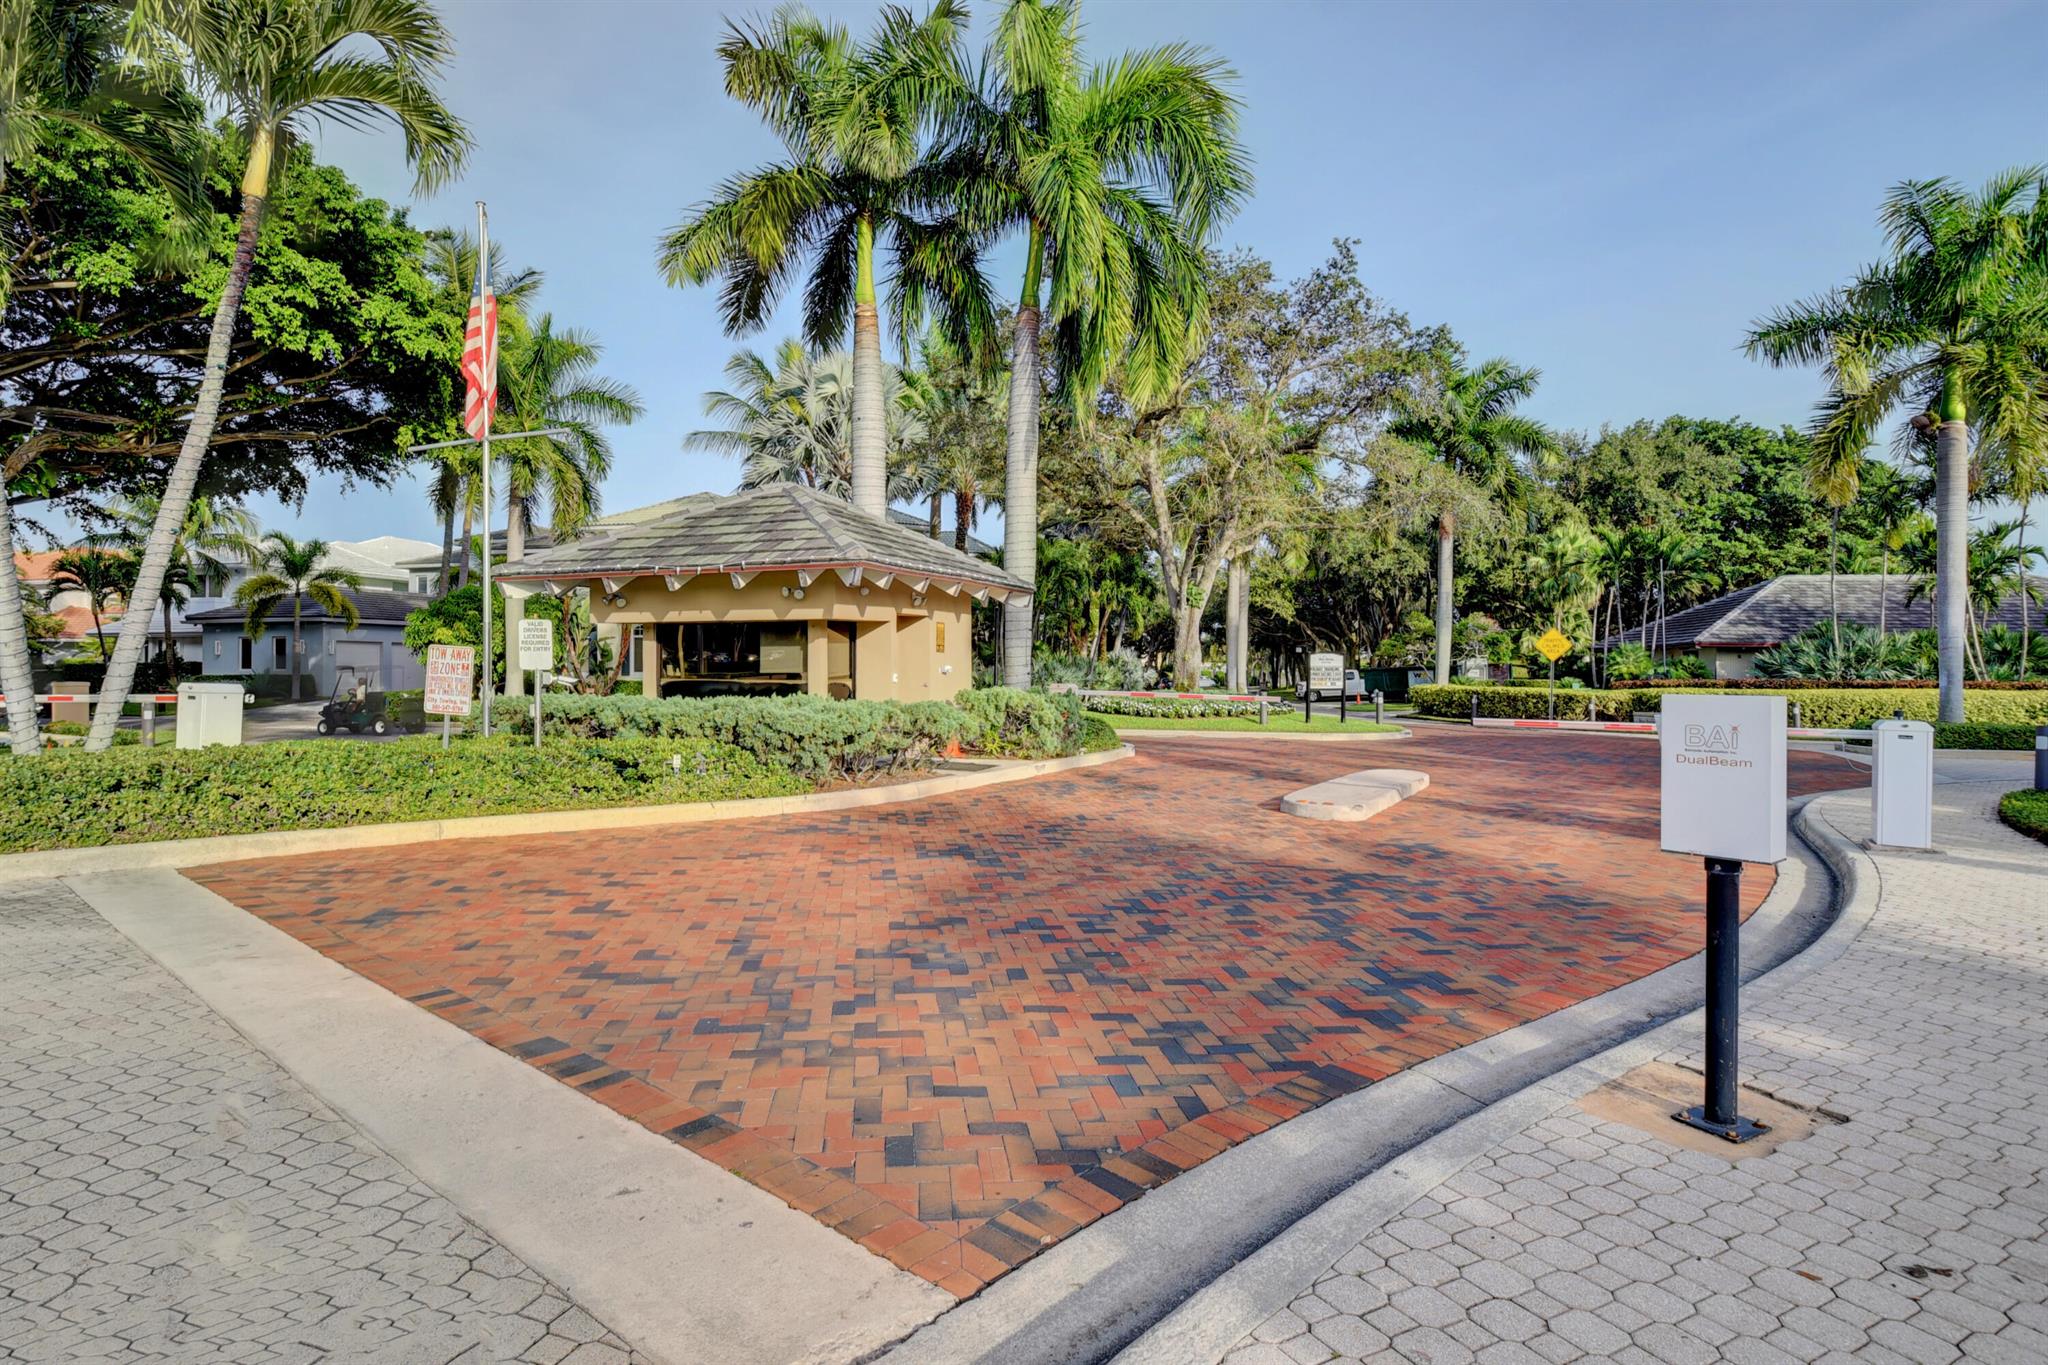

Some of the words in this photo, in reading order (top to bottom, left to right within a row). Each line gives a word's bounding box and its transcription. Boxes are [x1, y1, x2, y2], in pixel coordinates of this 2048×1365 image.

[431, 648, 447, 660] TOW
[450, 649, 471, 661] AWAY
[440, 662, 460, 675] ZONE
[1676, 753, 1752, 768] DualBeam
